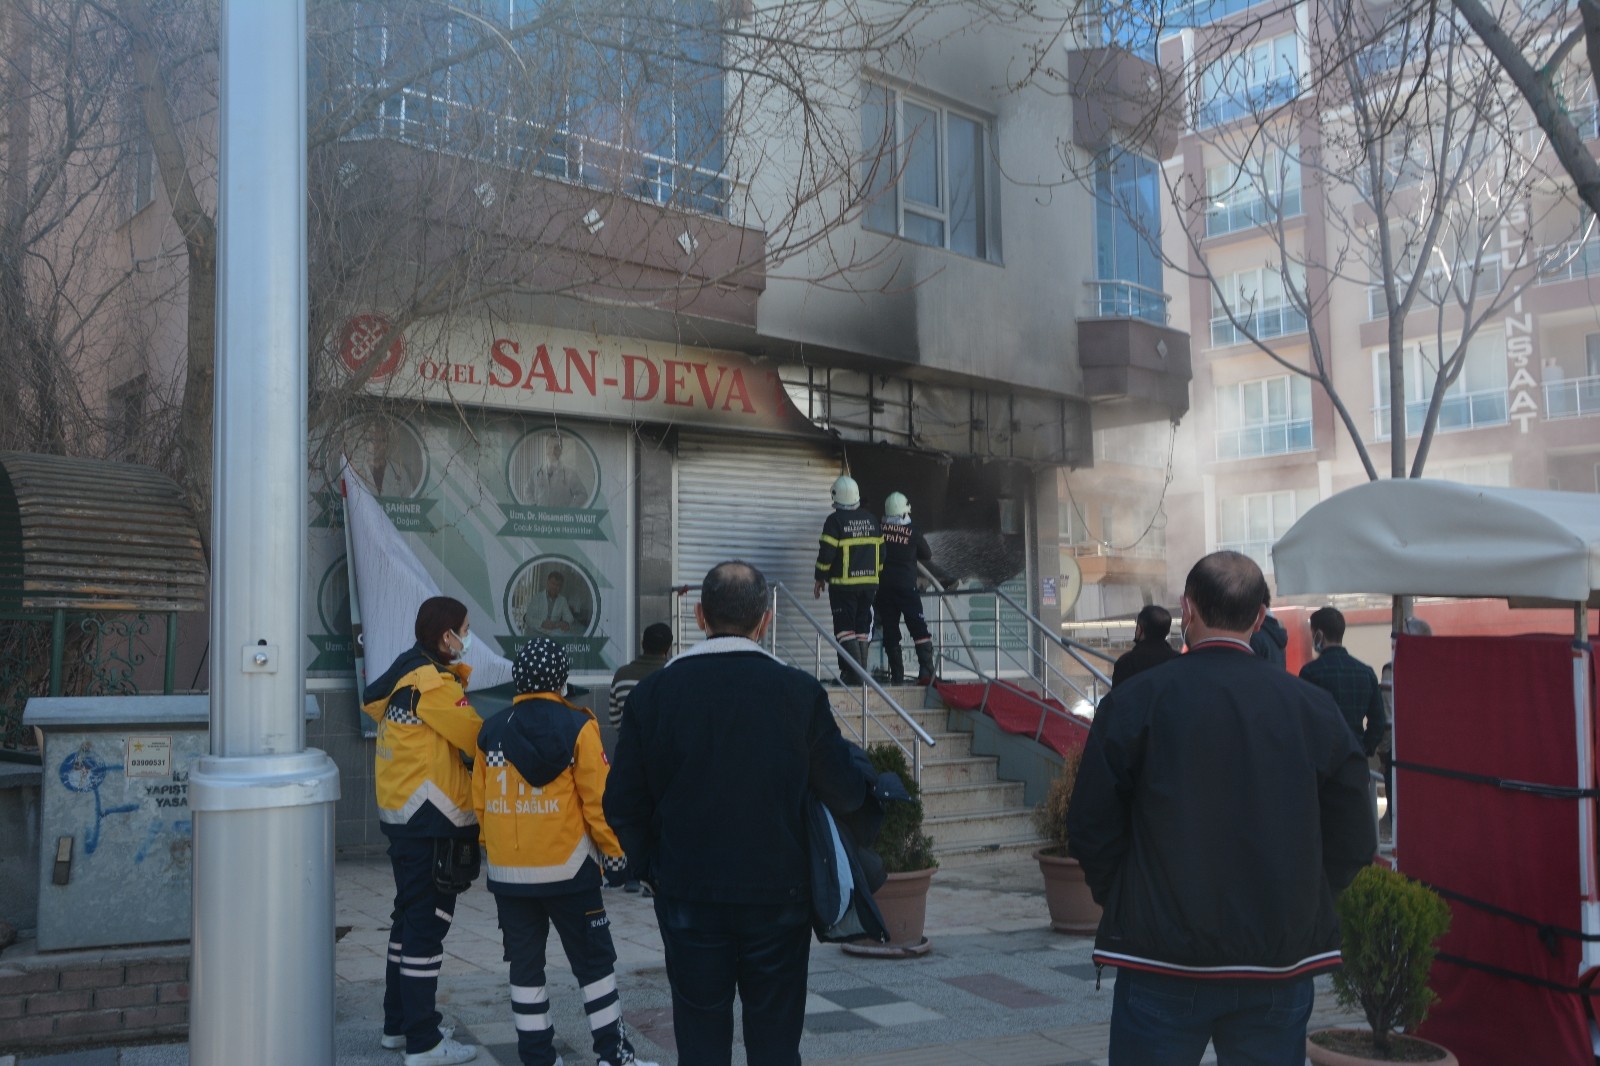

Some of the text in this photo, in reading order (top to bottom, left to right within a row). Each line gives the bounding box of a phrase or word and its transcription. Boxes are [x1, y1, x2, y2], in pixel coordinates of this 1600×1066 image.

[419, 355, 482, 386] ÖZEL
[489, 338, 757, 414] SAN-DEVA
[396, 517, 420, 526] Doğum
[575, 513, 597, 524] YAKUT
[144, 784, 189, 796] YAPIŞT
[155, 797, 188, 808] YASA
[486, 797, 560, 814] ACİL SAĞLIK
